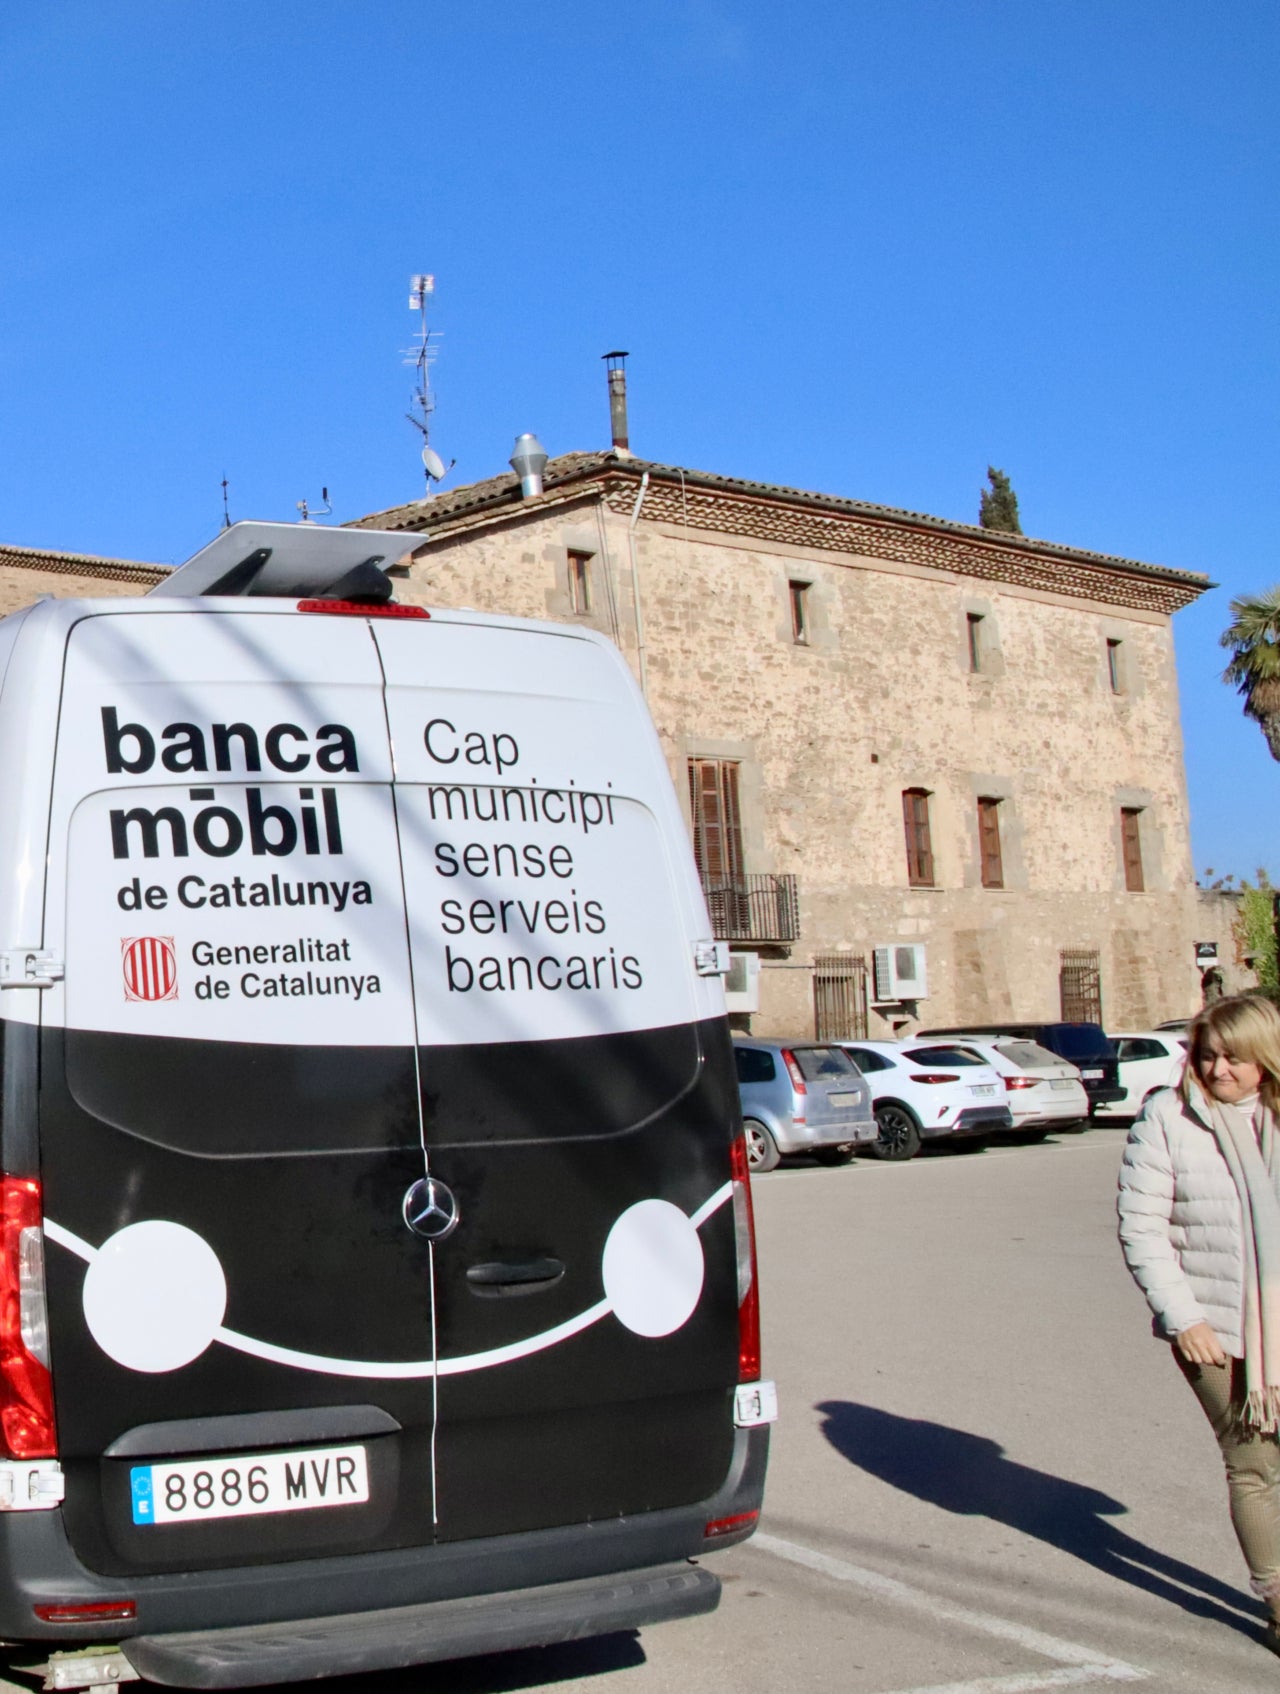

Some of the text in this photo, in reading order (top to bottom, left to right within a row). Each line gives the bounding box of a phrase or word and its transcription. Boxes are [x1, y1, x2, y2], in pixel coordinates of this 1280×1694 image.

[101, 706, 359, 774] banca
[423, 718, 519, 775] Cap
[427, 778, 615, 833] municipi
[434, 841, 574, 878] sense
[117, 874, 373, 912] de Catalunya
[441, 890, 606, 935] serveis
[192, 937, 351, 966] Generalitat
[445, 946, 643, 992] bancaris
[195, 970, 381, 1000] de Catalunya
[138, 1456, 357, 1514] E 8886 MVR
